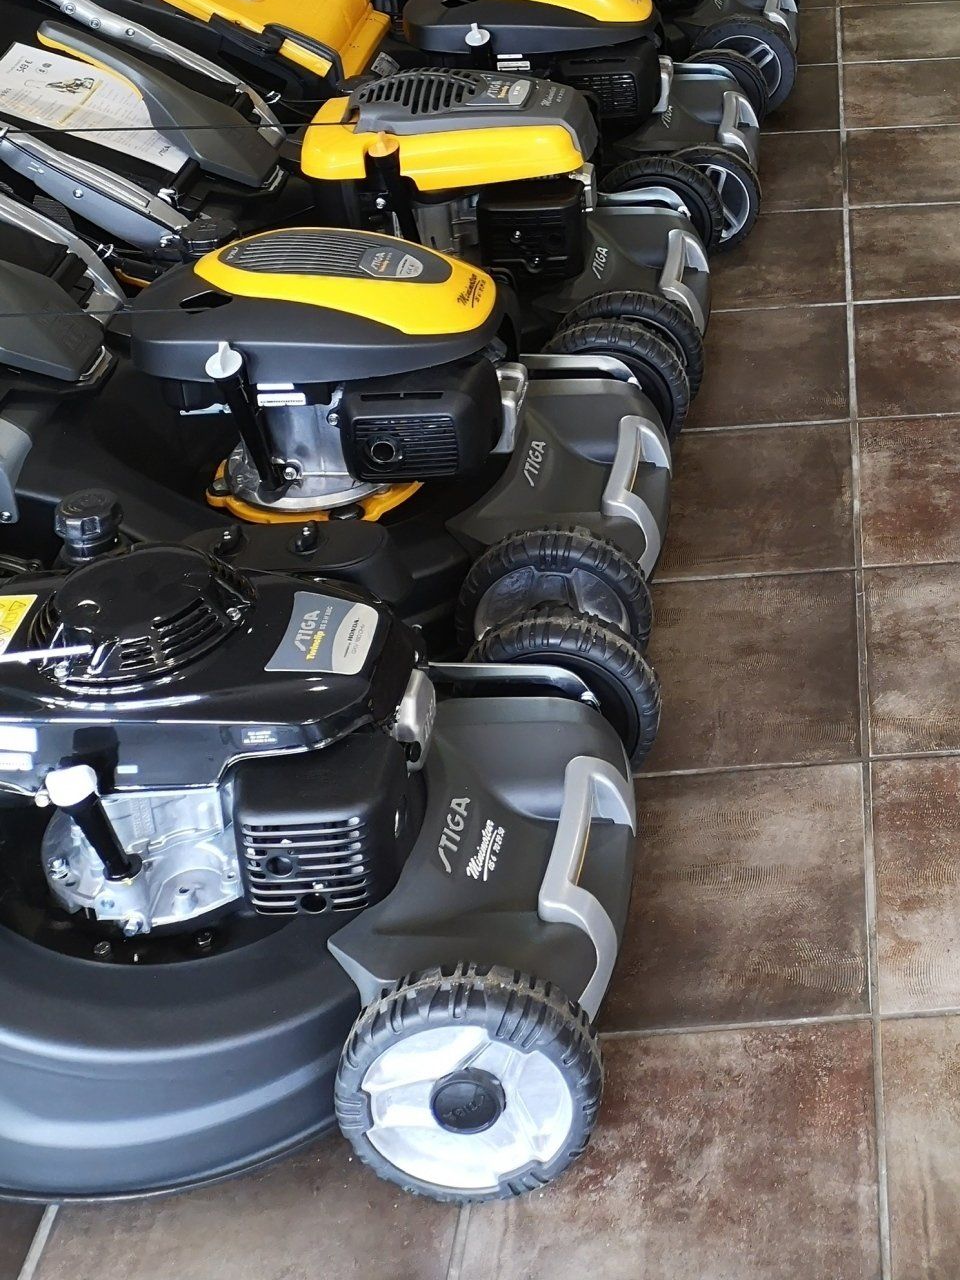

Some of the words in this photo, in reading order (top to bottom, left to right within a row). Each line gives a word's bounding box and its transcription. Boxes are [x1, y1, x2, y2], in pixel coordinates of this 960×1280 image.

[591, 245, 609, 280] STIGA
[523, 440, 546, 487] STIGA
[295, 610, 321, 652] STIGA
[306, 630, 326, 661] Twinclip
[347, 619, 360, 642] HONDA
[438, 797, 471, 874] STIGA
